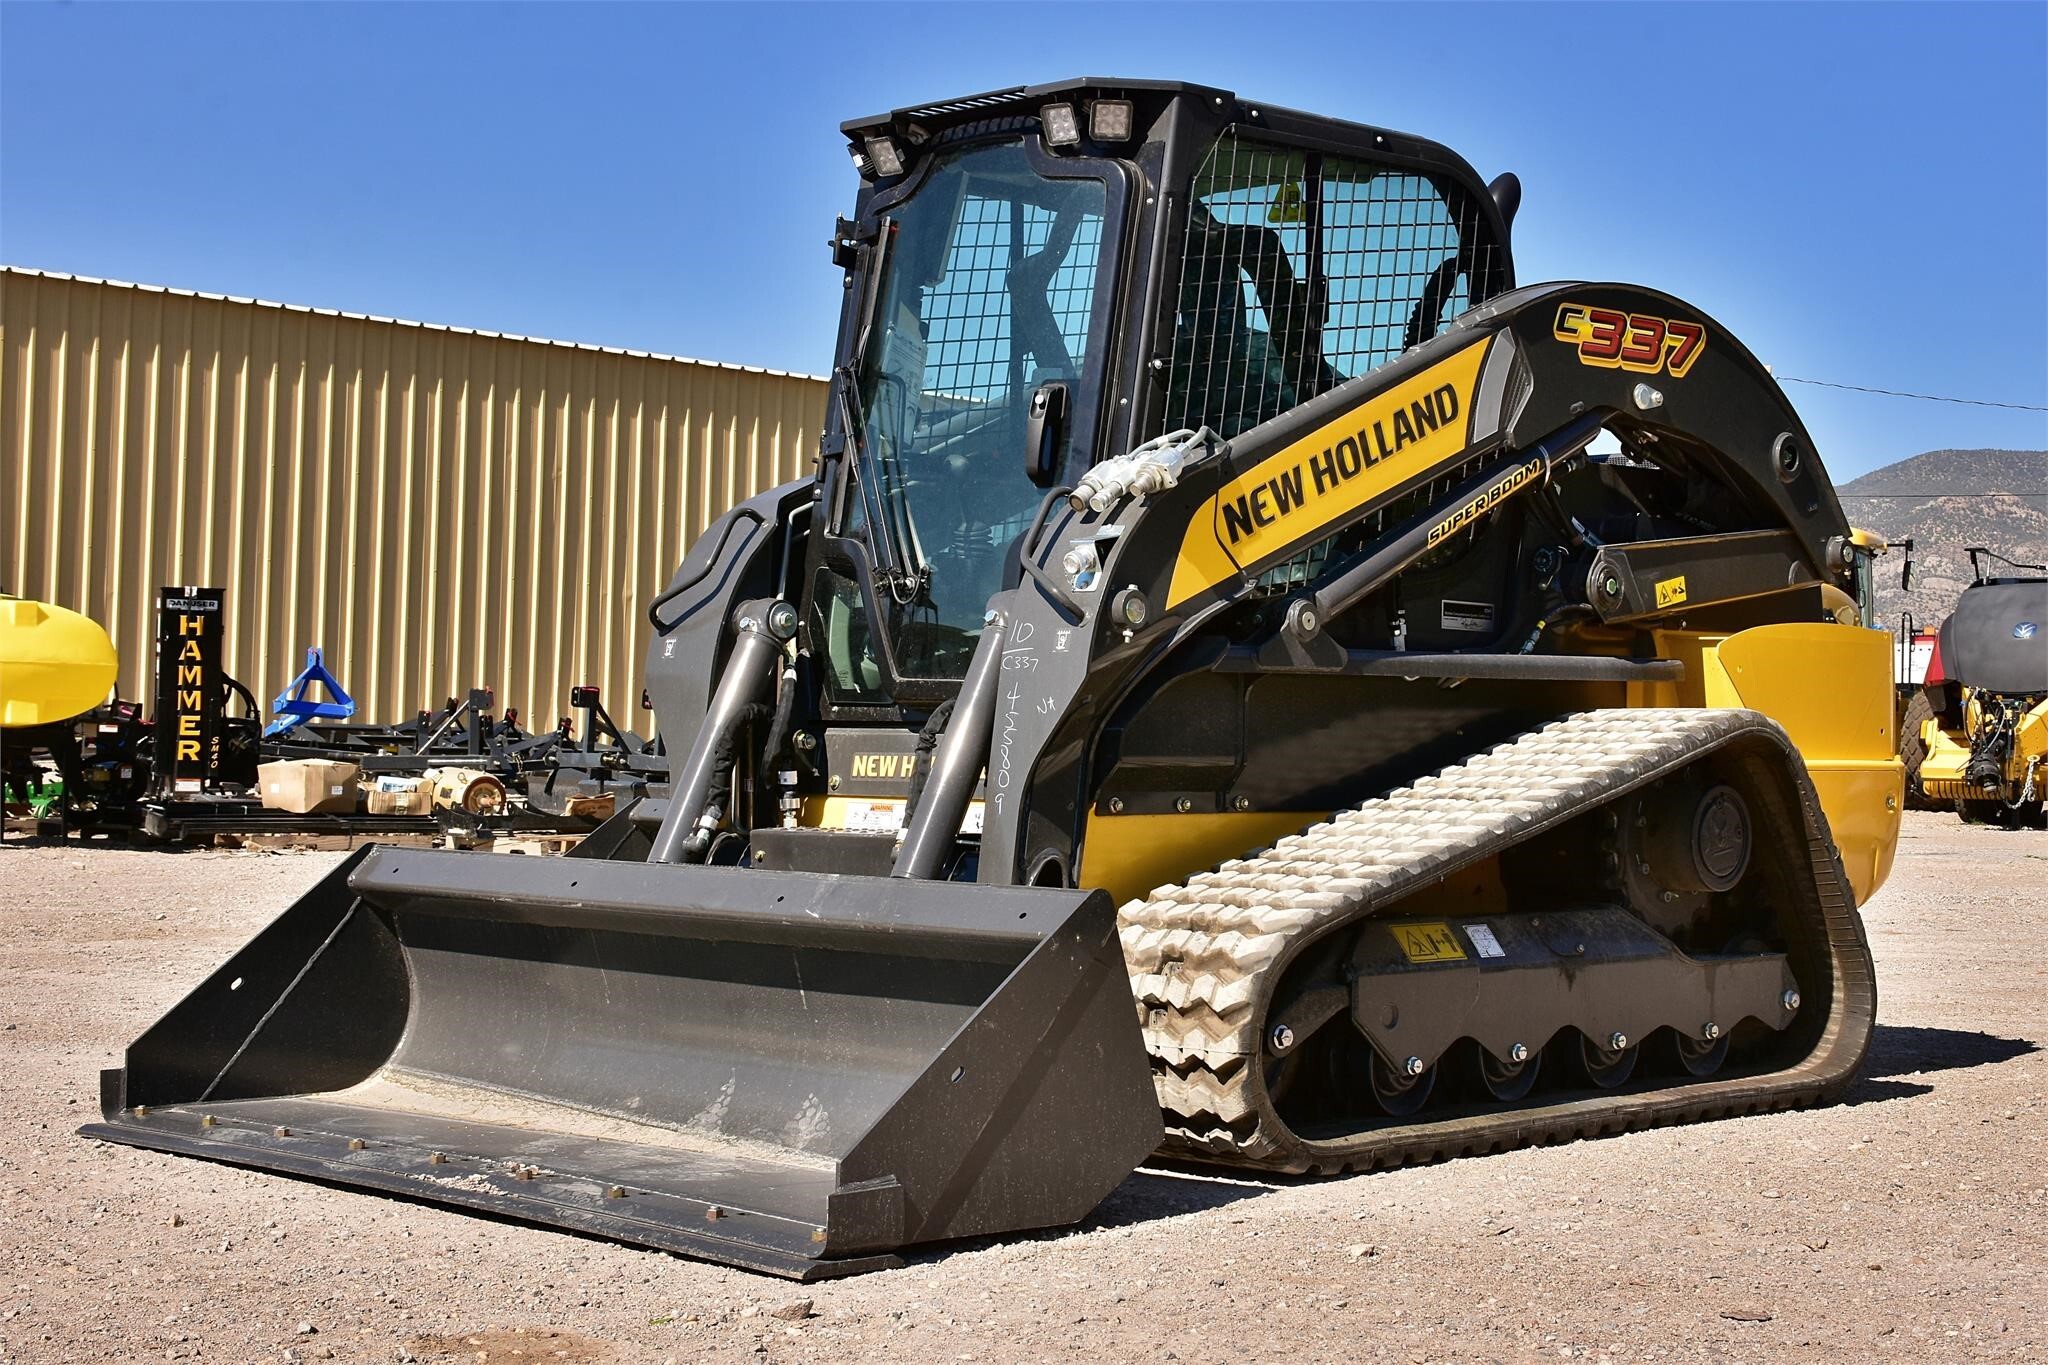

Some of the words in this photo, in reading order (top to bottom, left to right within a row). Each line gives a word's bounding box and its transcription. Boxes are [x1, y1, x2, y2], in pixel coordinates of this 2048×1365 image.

[1554, 303, 1706, 377] C337
[1221, 464, 1305, 545] NEW
[1308, 382, 1460, 497] HOLLAND
[1428, 494, 1489, 548] SUPER
[1489, 459, 1540, 507] BOOM
[177, 614, 204, 761] HAMMER
[1002, 656, 1039, 672] C337
[210, 736, 220, 769] SM40
[852, 755, 898, 778] NEW
